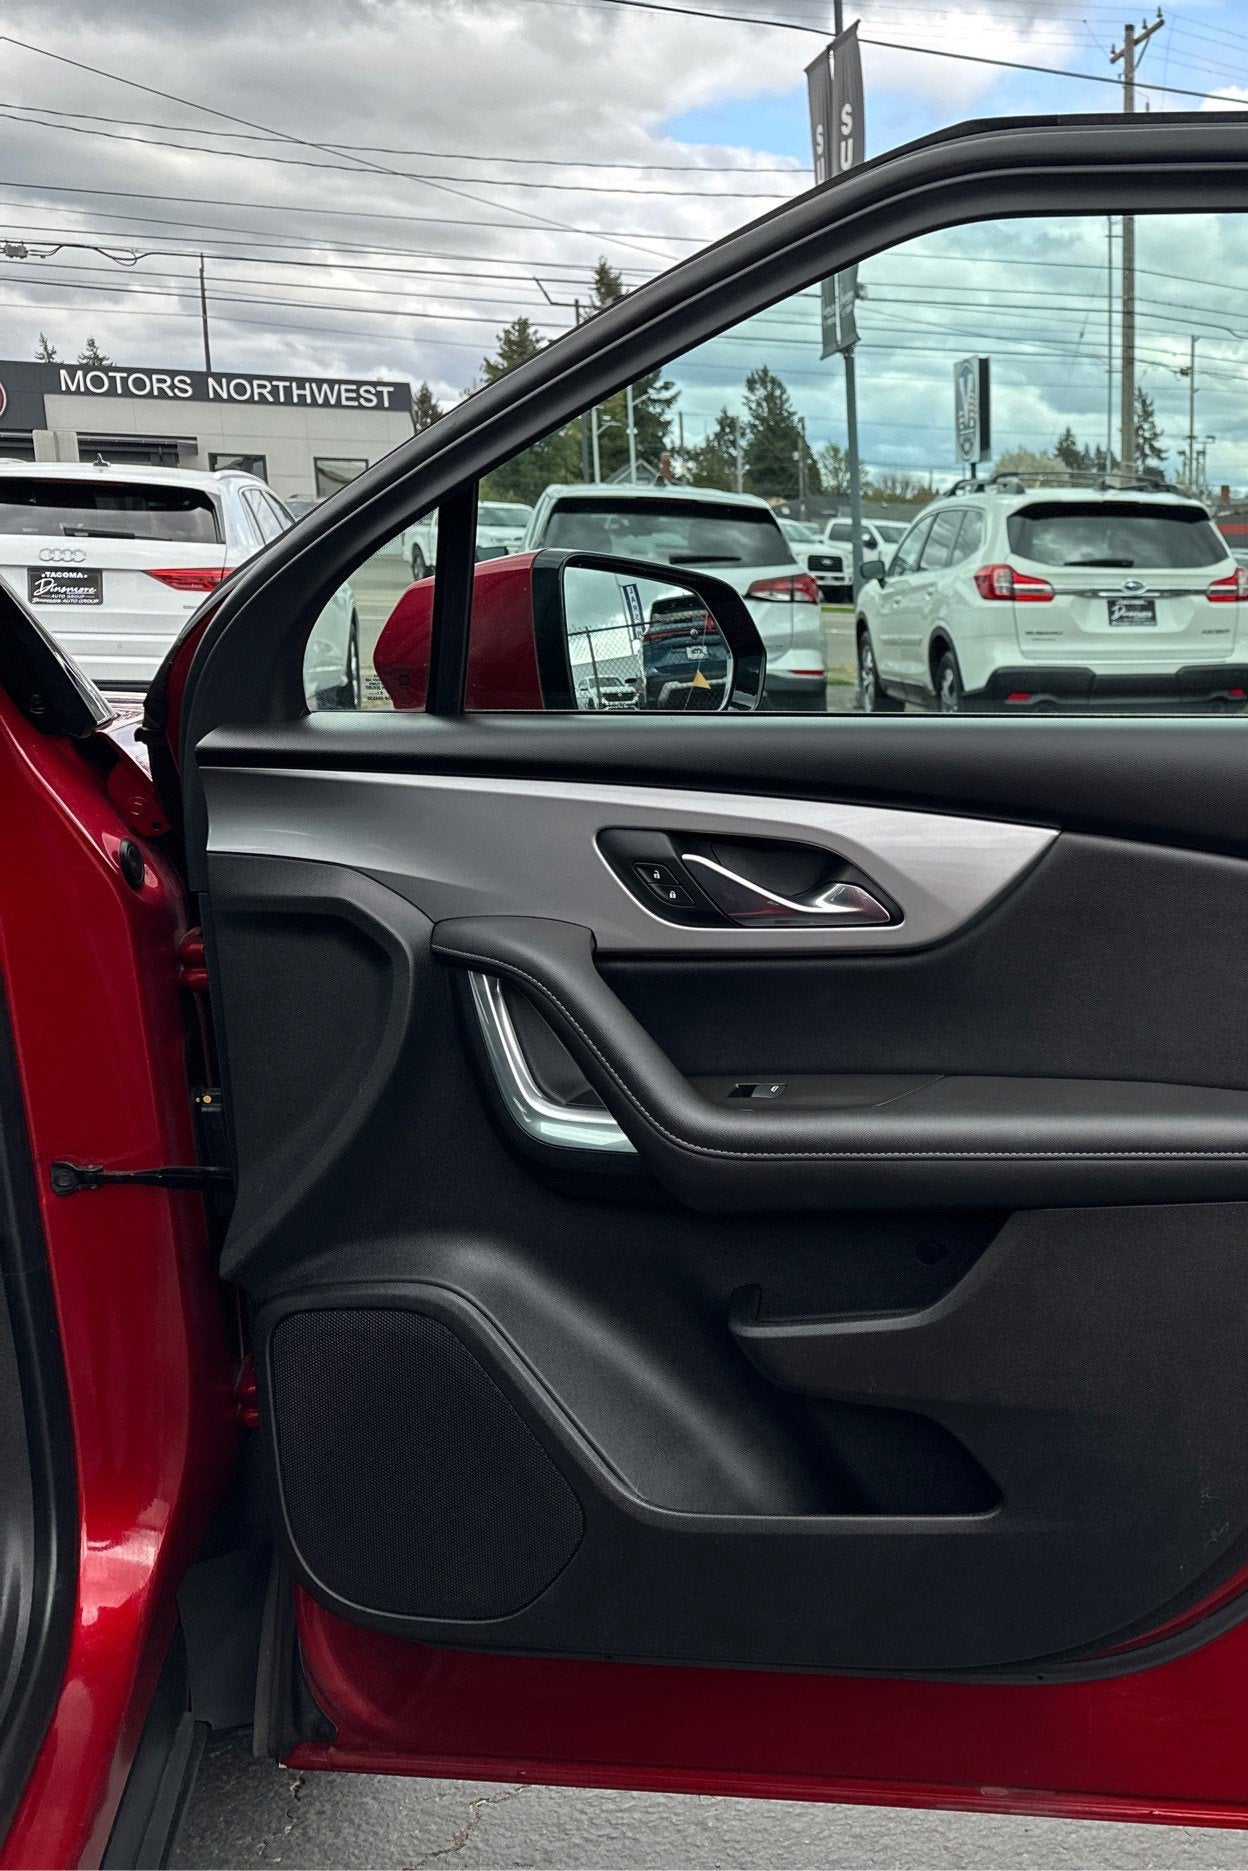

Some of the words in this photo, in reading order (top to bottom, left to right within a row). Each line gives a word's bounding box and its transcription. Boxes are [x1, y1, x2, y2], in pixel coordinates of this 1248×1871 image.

[59, 368, 193, 398] MOTORS
[207, 377, 395, 408] NORTHWEST
[44, 571, 84, 579] TACOMA
